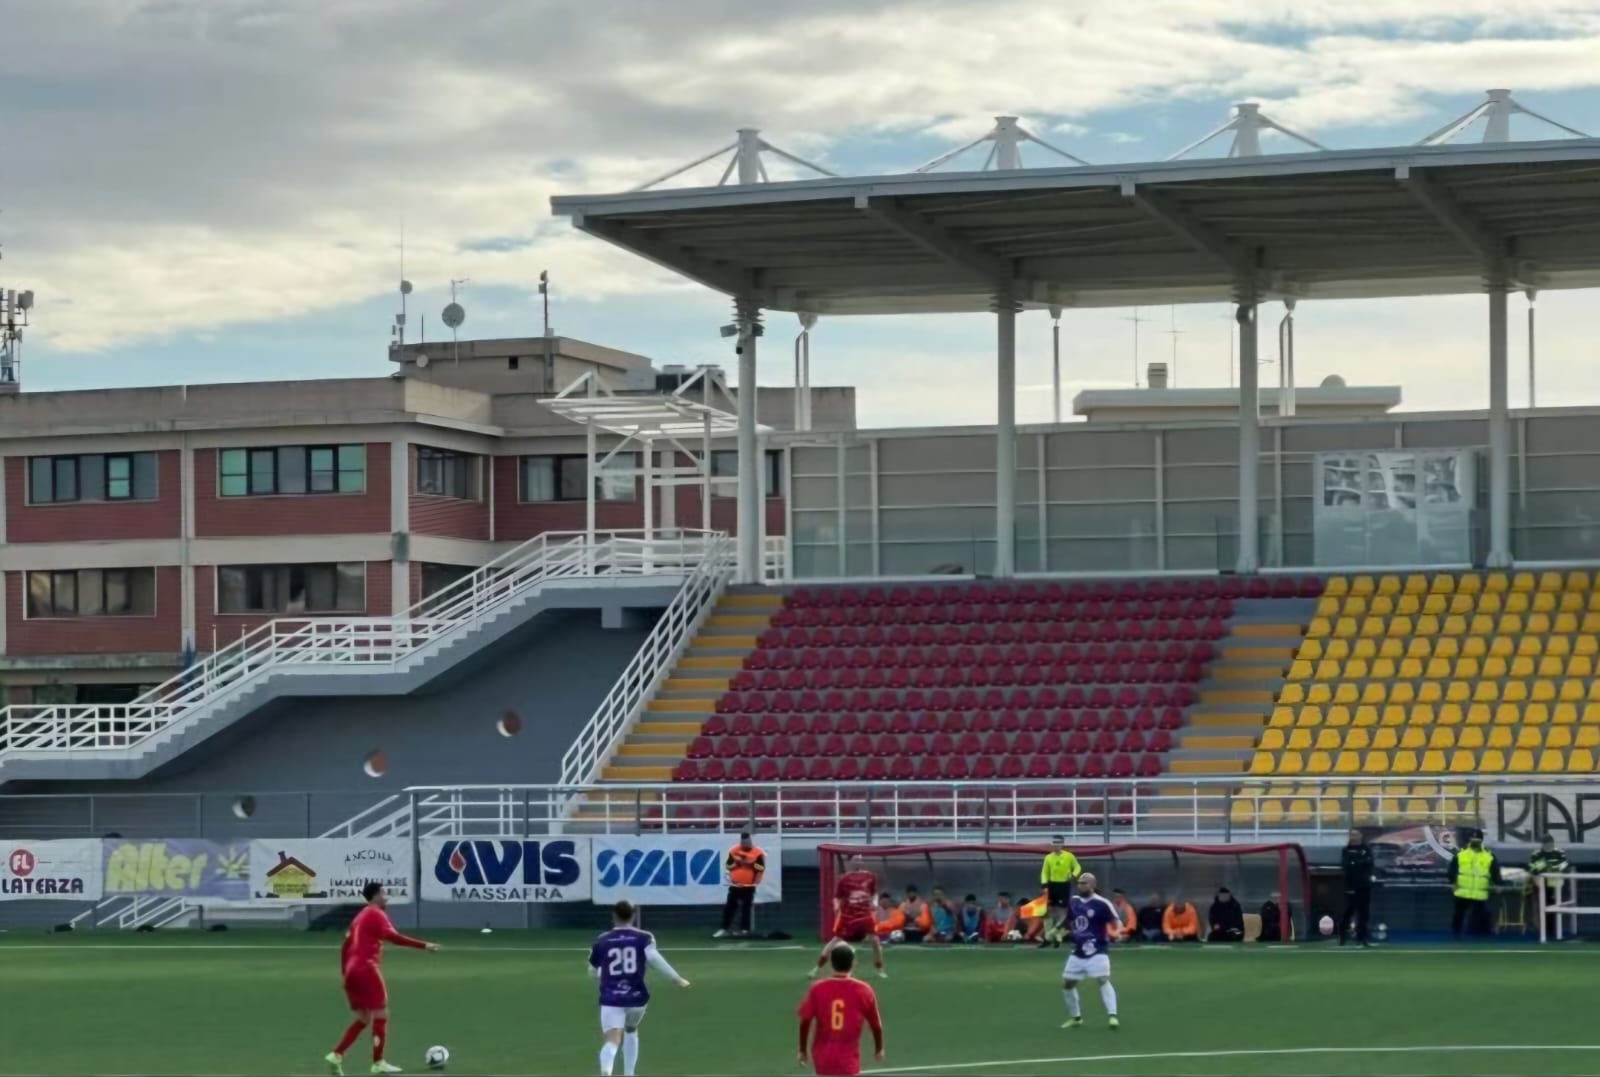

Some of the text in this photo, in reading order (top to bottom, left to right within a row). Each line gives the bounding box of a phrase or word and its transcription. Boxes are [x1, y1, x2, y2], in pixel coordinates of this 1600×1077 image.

[12, 854, 31, 871] FL
[434, 841, 580, 885] AVIS
[2, 878, 84, 894] LATERZA
[452, 887, 564, 901] MASSAFRA
[607, 946, 637, 976] 28
[830, 999, 845, 1030] 6
